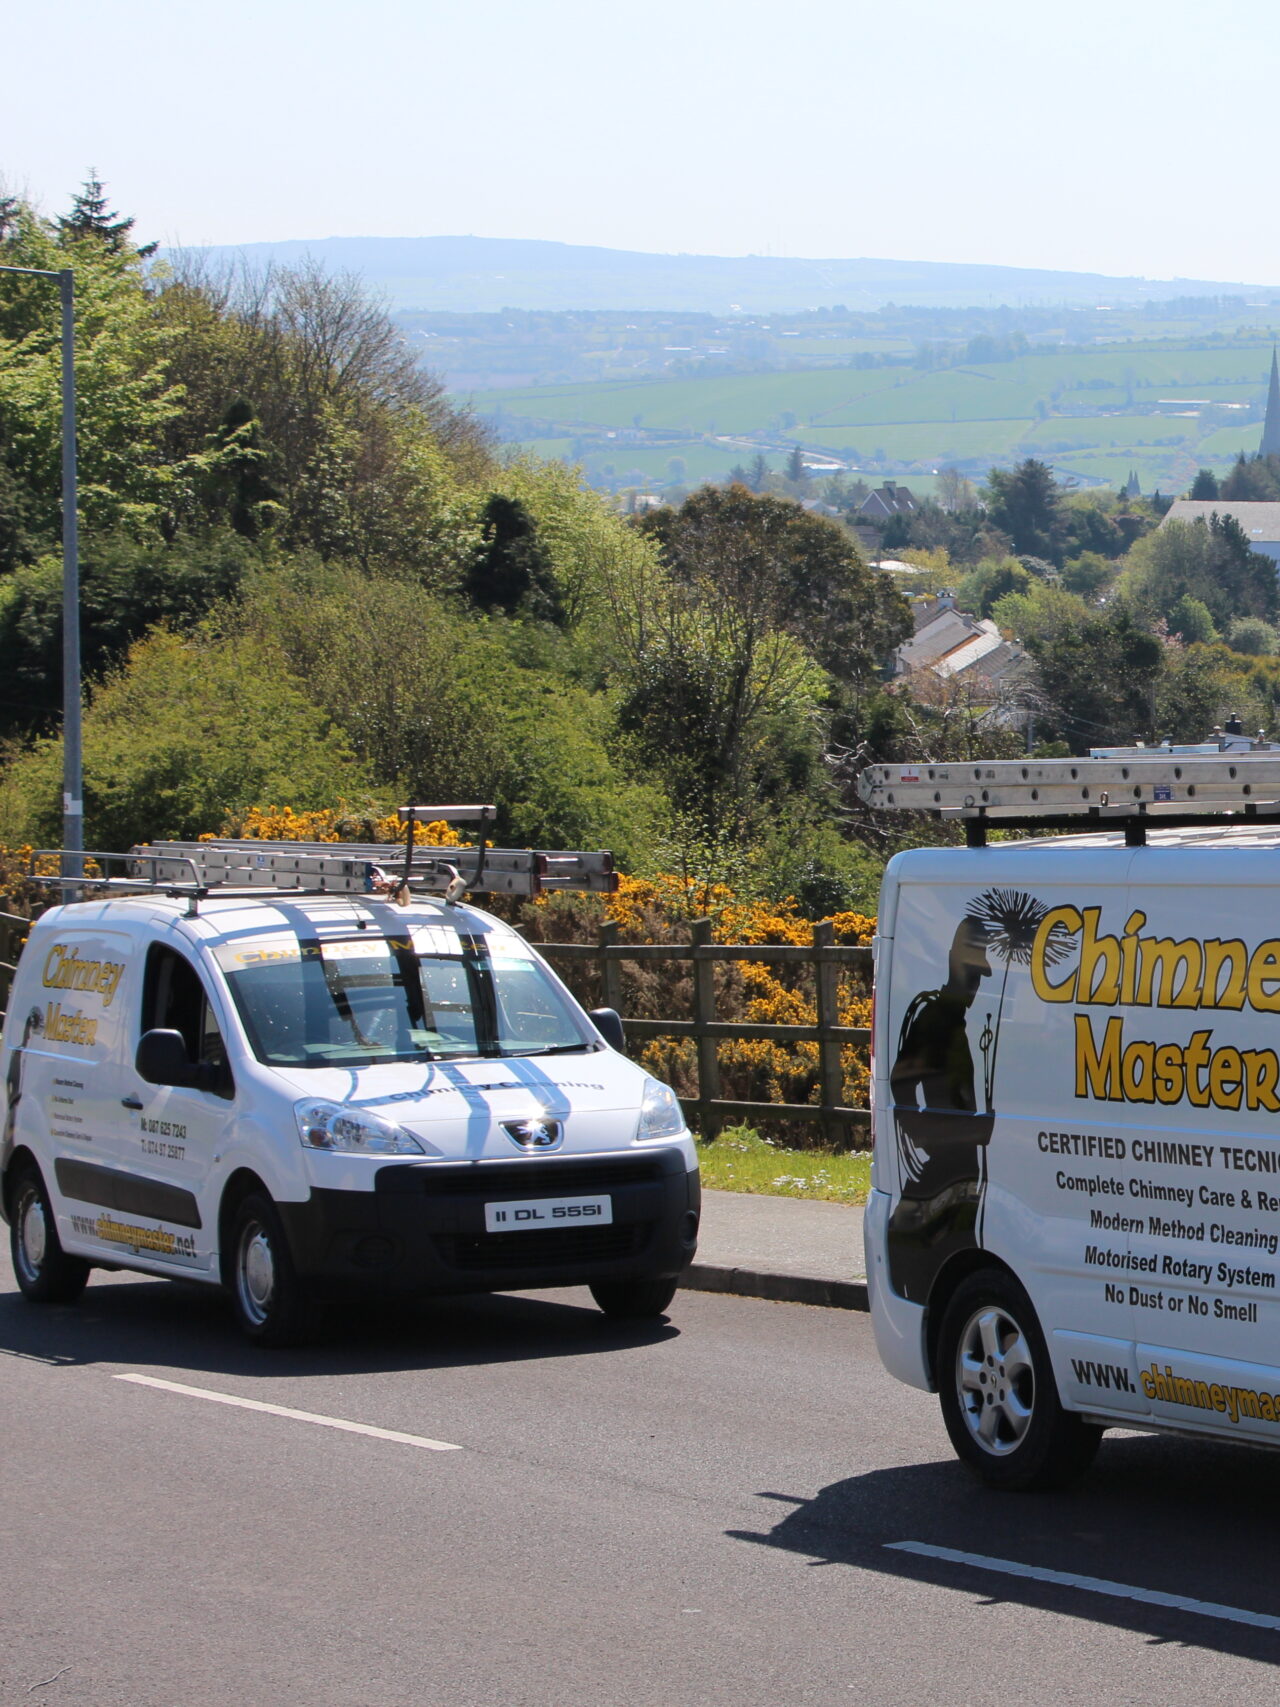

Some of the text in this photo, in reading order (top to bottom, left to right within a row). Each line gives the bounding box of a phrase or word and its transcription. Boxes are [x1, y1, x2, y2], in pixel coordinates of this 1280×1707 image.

[42, 944, 125, 1007] Chimney
[389, 1083, 492, 1101] Chimney
[1037, 1131, 1126, 1160] CERTIFIED
[1131, 1139, 1214, 1168] CHIMNEY
[1056, 1171, 1125, 1197] Complete
[1129, 1178, 1194, 1208] Chimney
[1198, 1185, 1235, 1207] Care
[1241, 1189, 1252, 1209] &
[495, 1204, 602, 1222] 11 DL 5551
[1090, 1209, 1278, 1255] Modern Method Cleaning
[70, 1212, 197, 1258] www.chimneymaster.net
[1084, 1245, 1276, 1288] Motorised Rotary System
[1105, 1283, 1257, 1323] No Dust or No Smell
